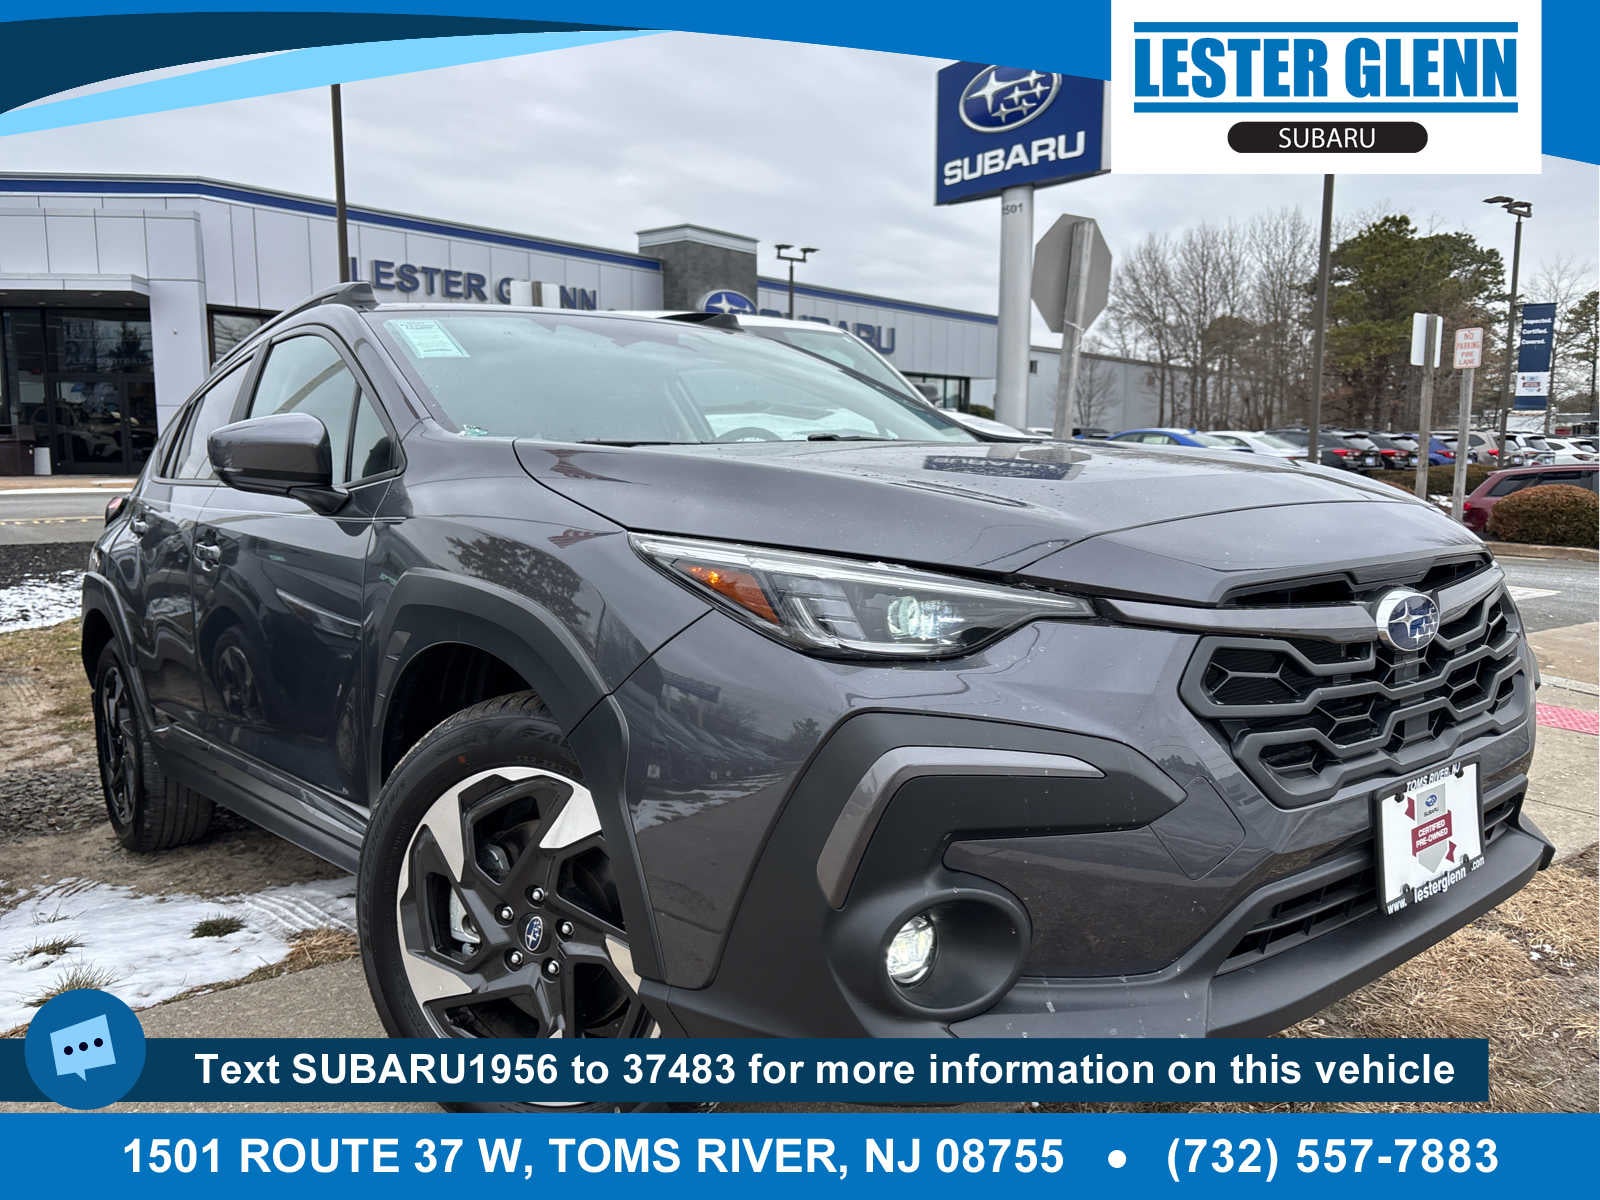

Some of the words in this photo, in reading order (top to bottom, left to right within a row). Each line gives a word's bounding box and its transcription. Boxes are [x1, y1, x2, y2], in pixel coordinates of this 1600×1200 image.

[943, 131, 1085, 186] SUBARU
[1456, 342, 1479, 350] PARKING
[1406, 776, 1429, 792] TOMS
[1451, 761, 1461, 776] NJ
[1415, 828, 1449, 848] PRE-OWNED
[1417, 819, 1446, 838] CERTIFIED
